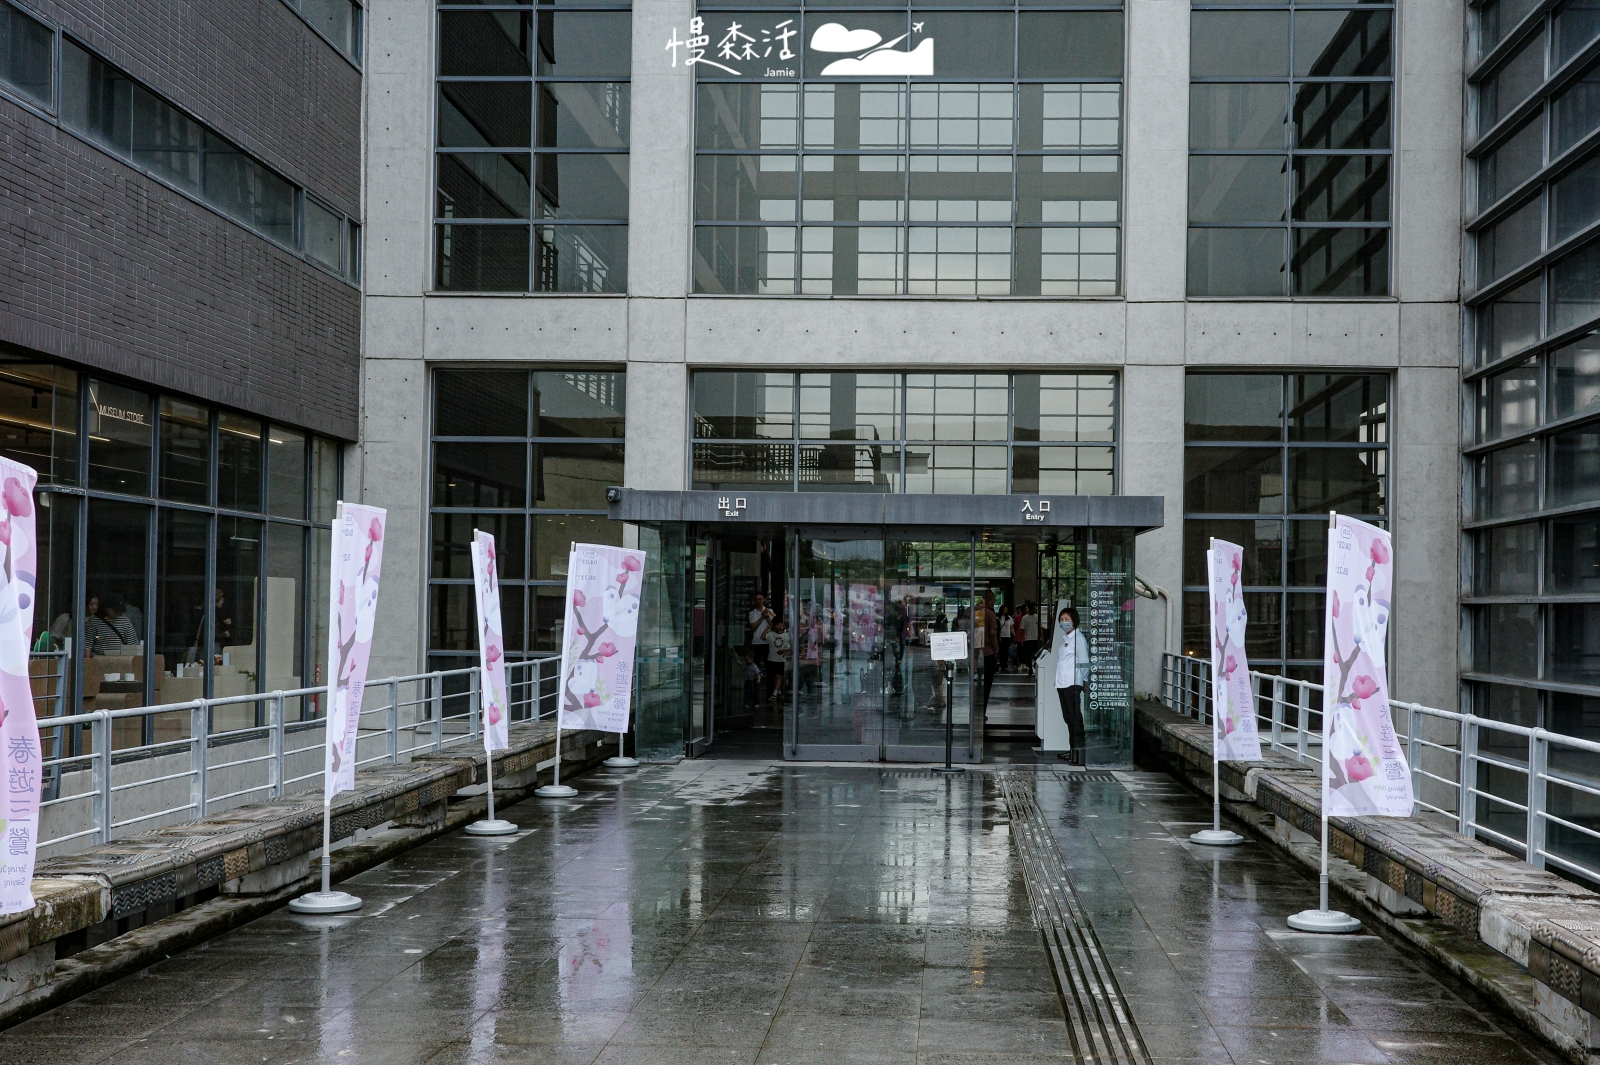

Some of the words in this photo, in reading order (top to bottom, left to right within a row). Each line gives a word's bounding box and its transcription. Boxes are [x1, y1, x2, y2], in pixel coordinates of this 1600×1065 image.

[100, 404, 126, 419] MUSEUM
[126, 411, 144, 424] STORE
[718, 496, 747, 510] 出口
[1021, 500, 1050, 512] 入口
[1025, 513, 1045, 522] Entry
